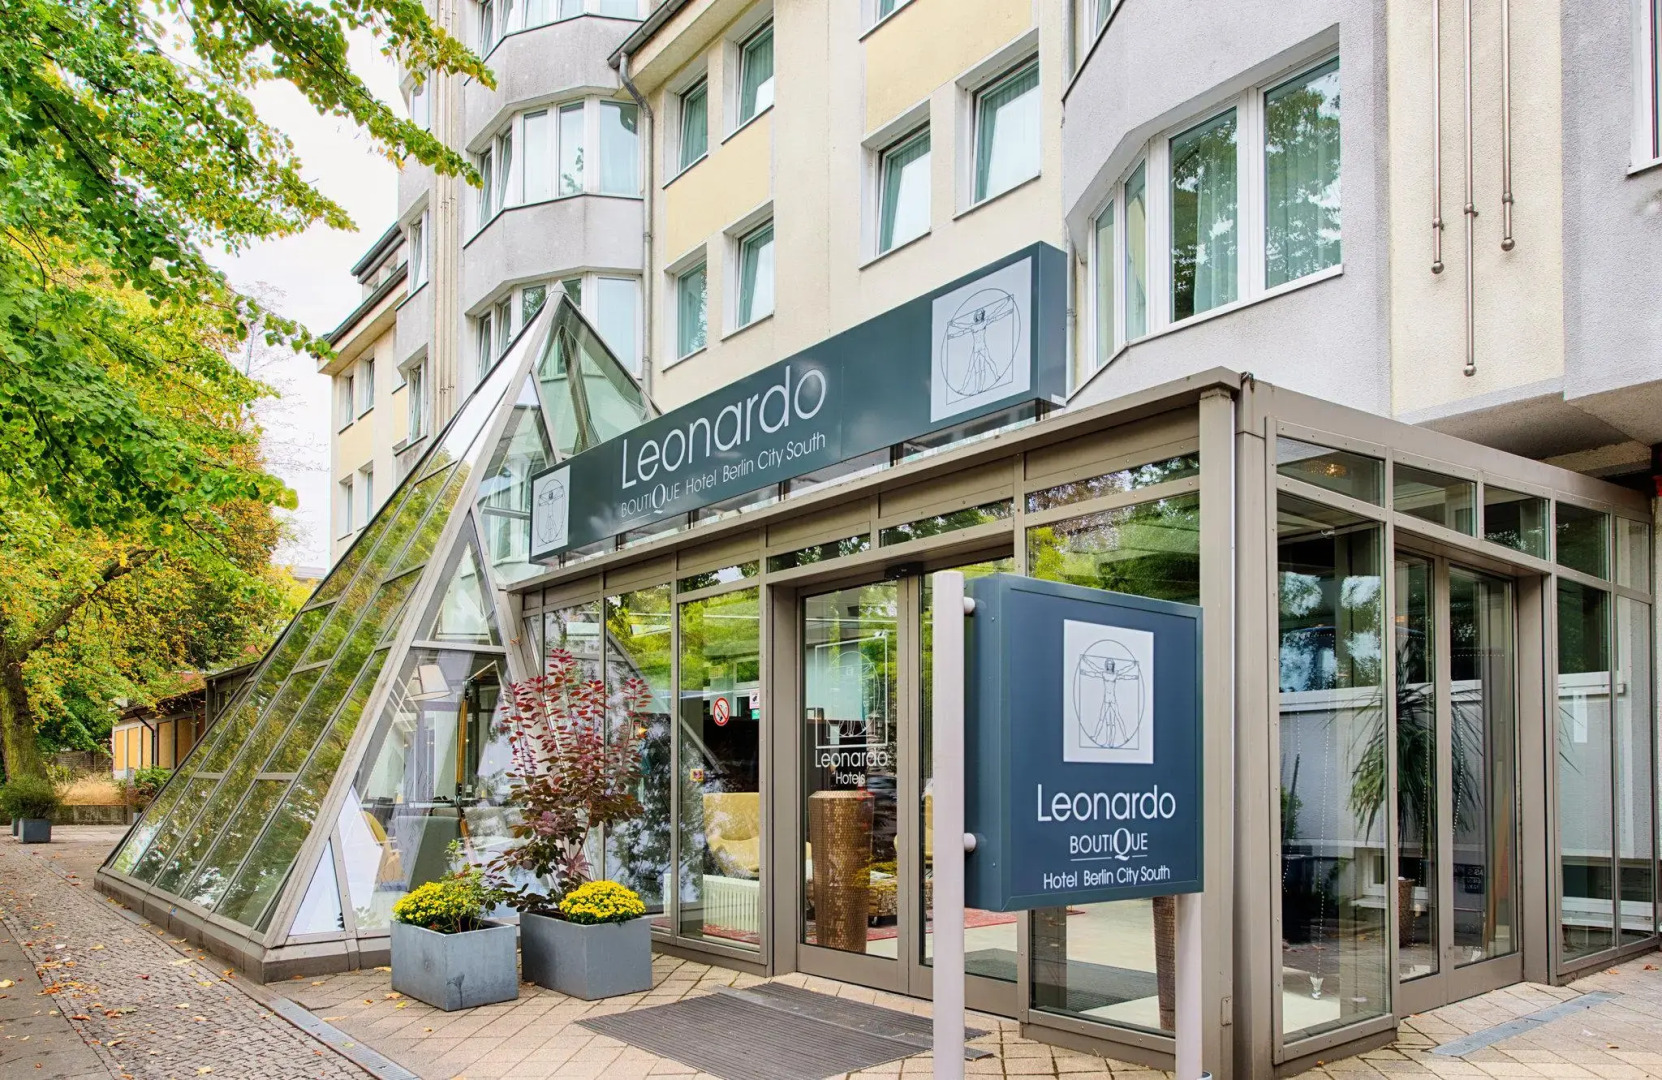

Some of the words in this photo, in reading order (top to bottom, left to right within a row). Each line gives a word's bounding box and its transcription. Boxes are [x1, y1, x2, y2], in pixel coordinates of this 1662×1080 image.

[622, 365, 827, 490] Leonardo
[620, 483, 680, 518] BOUTIQUE
[685, 470, 717, 496] Hotel
[722, 458, 754, 483] Berlin
[757, 449, 784, 469] City
[786, 431, 826, 461] South
[815, 747, 889, 768] Leonardo
[835, 771, 867, 786] Hotels
[1037, 783, 1177, 822] Leonardo
[1069, 827, 1149, 861] BOUTIQUE
[1043, 870, 1078, 890] Hotel
[1083, 868, 1114, 887] Berlin
[1116, 866, 1139, 885] City
[1140, 864, 1171, 882] South
